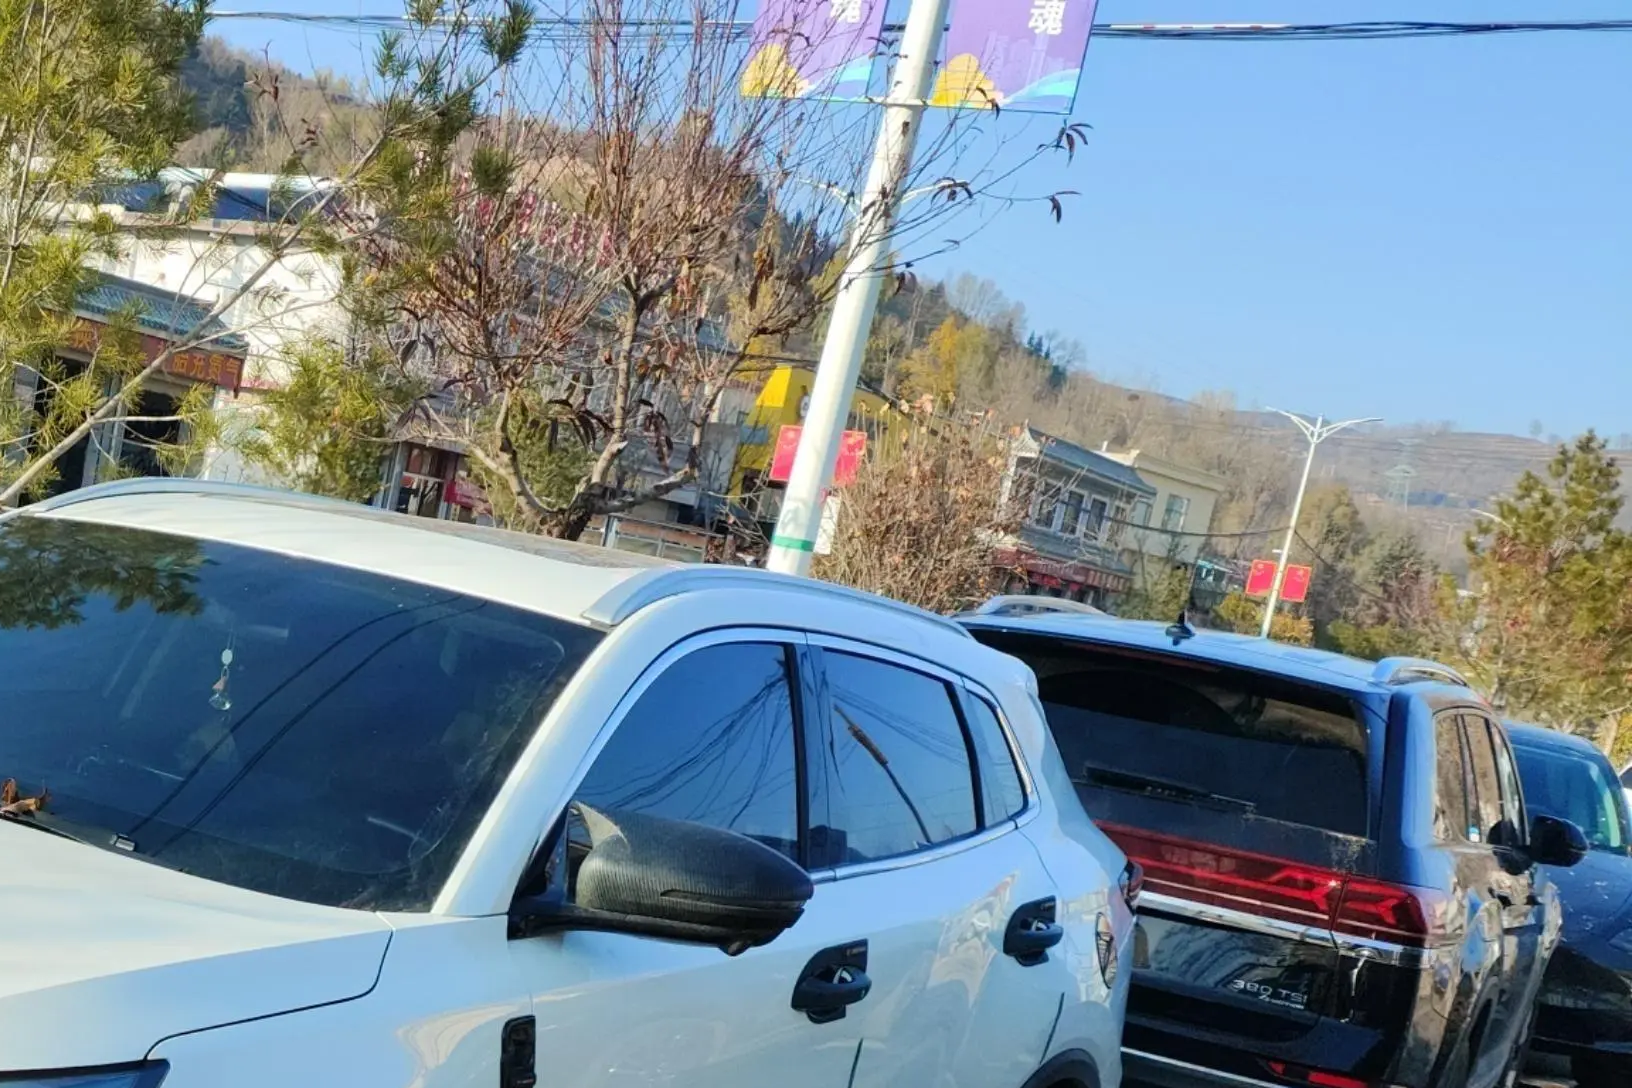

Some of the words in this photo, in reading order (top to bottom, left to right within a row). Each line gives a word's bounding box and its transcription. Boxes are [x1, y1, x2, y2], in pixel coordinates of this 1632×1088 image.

[1028, 0, 1066, 35] 魂
[1232, 979, 1273, 995] 380
[1278, 988, 1308, 1003] TSI
